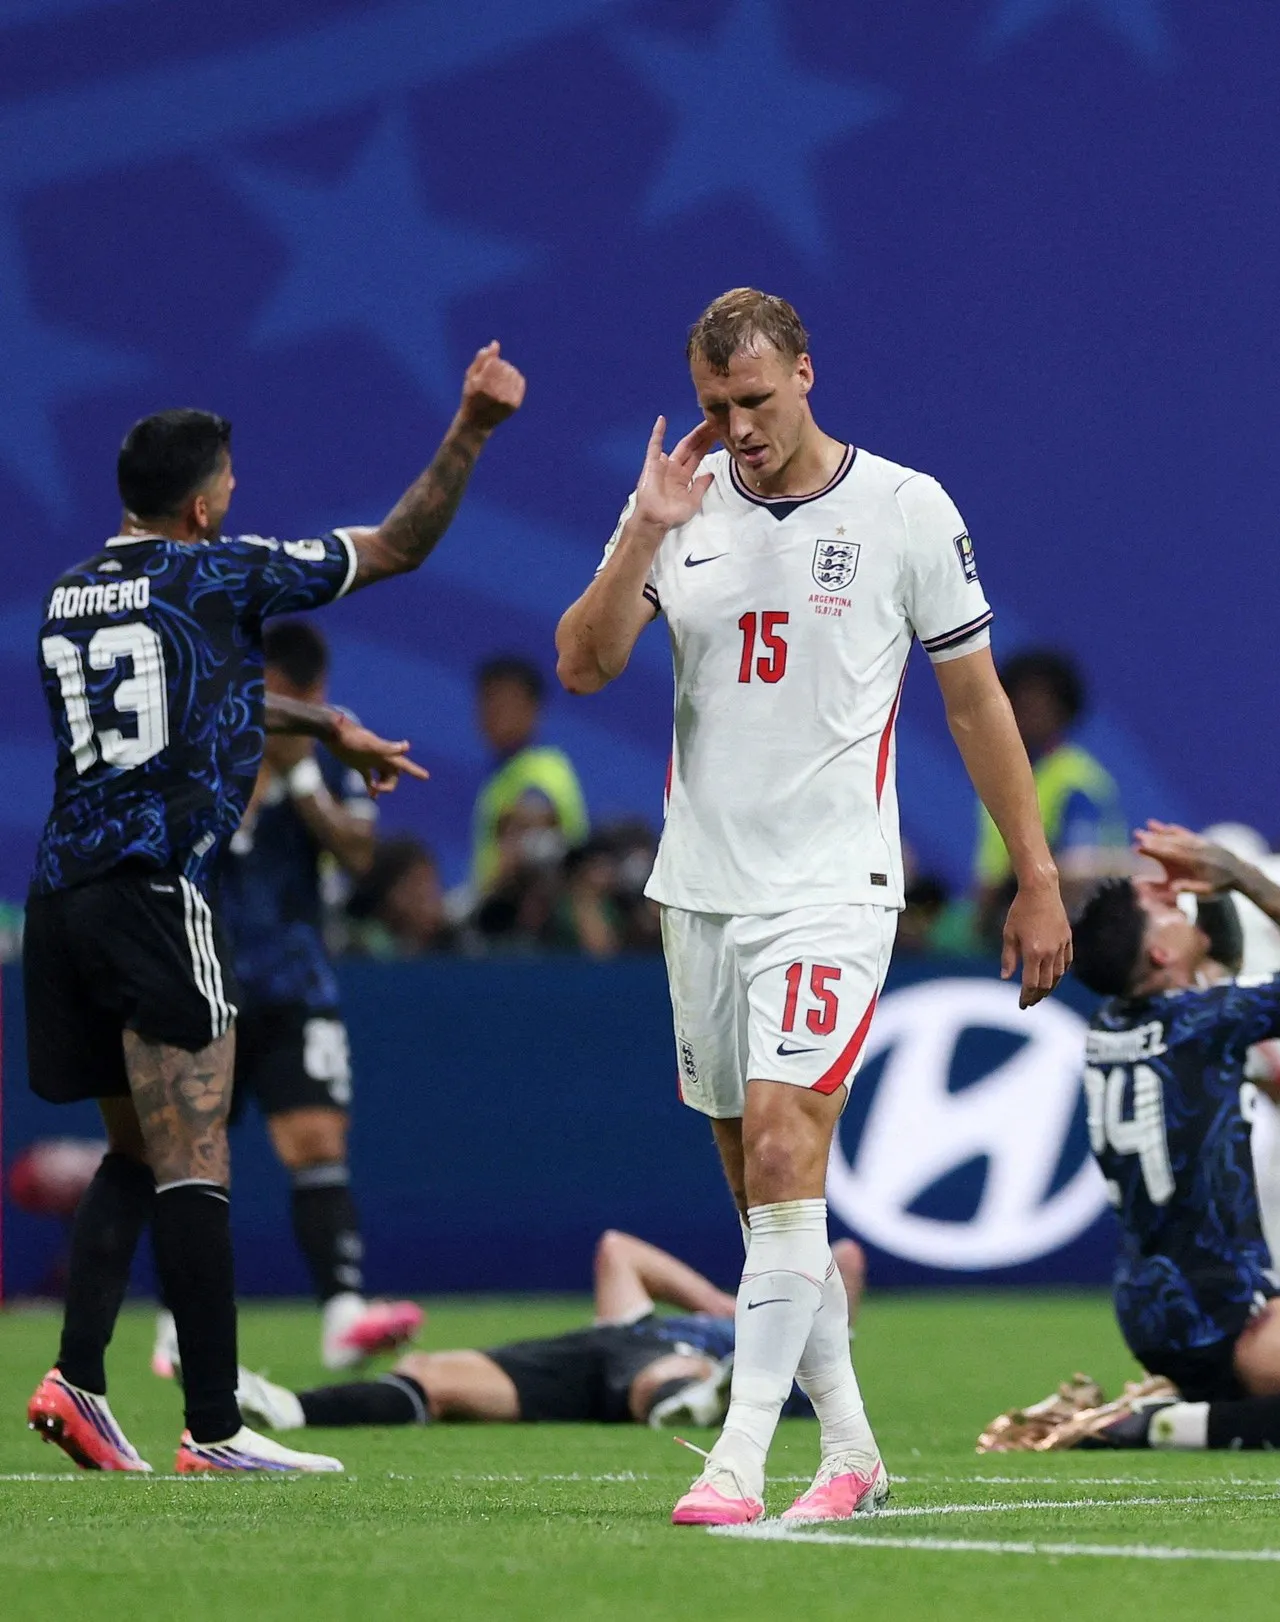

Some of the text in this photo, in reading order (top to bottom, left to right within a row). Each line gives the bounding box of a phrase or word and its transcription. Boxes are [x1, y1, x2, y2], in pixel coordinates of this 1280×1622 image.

[48, 576, 150, 619] ROMERO
[808, 594, 853, 608] ARGENTINA
[738, 611, 789, 683] 15
[42, 621, 169, 775] 13
[782, 962, 842, 1036] 15
